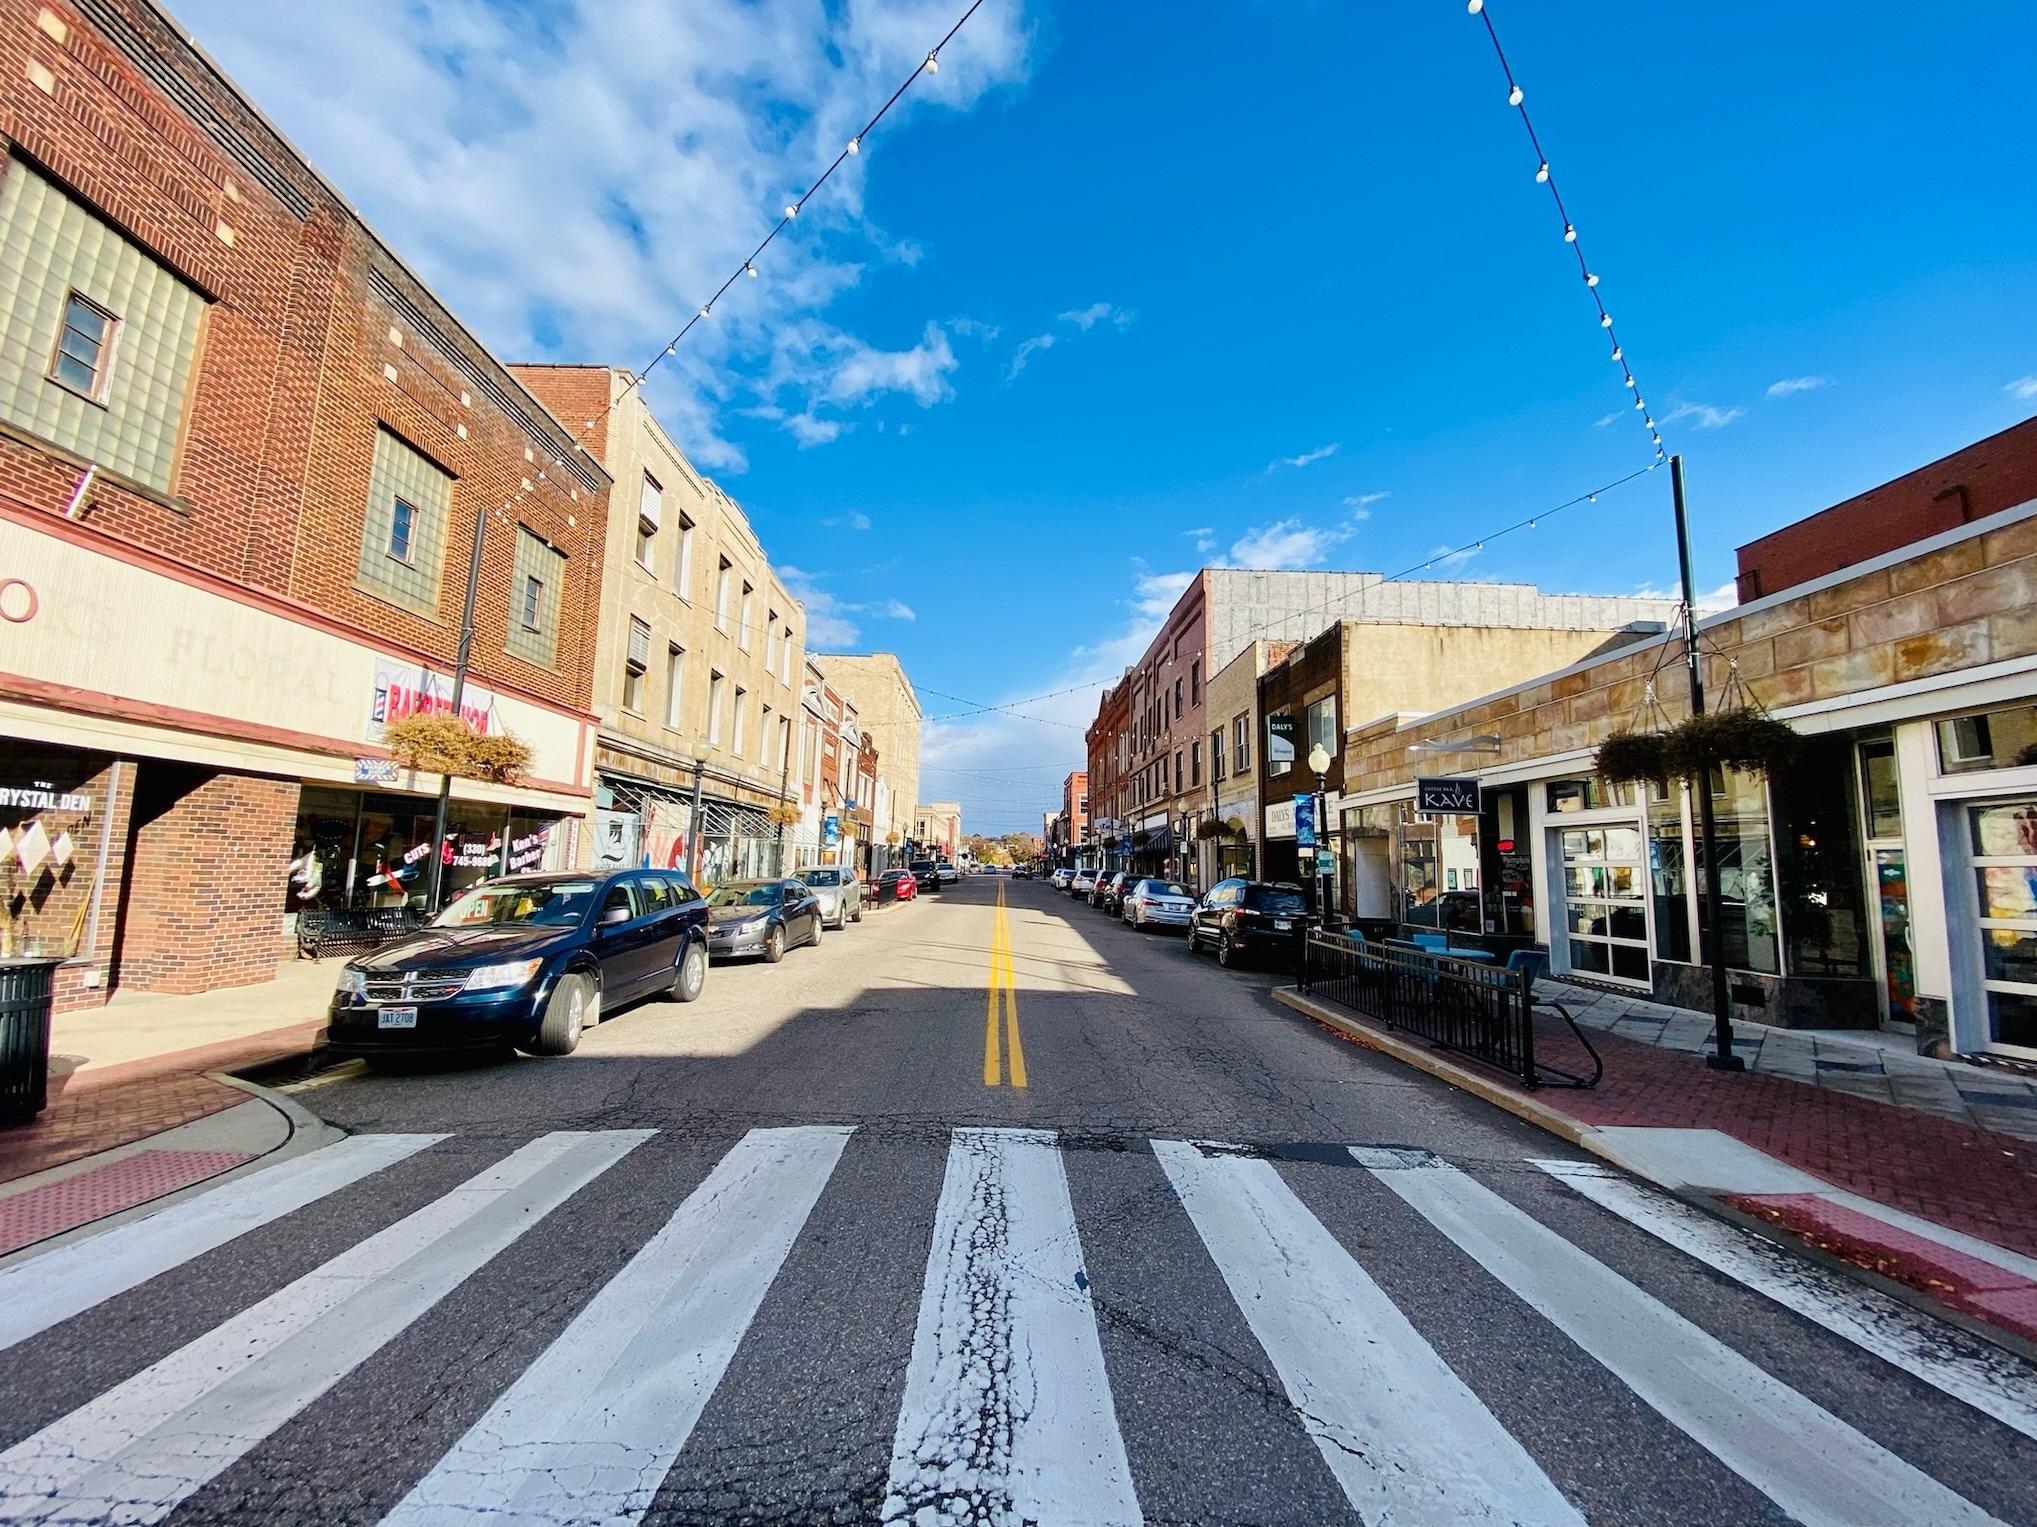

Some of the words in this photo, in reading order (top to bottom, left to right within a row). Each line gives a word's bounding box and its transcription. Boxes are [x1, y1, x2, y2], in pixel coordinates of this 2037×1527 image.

[1271, 723, 1293, 731] DALY'S
[34, 781, 54, 789] THE
[60, 793, 92, 811] DEN
[1271, 806, 1290, 823] DALY'S
[462, 843, 486, 856] (330)
[511, 833, 538, 853] Ken's
[403, 842, 431, 864] CUTS
[509, 848, 542, 870] Barber
[460, 899, 489, 919] OPEN
